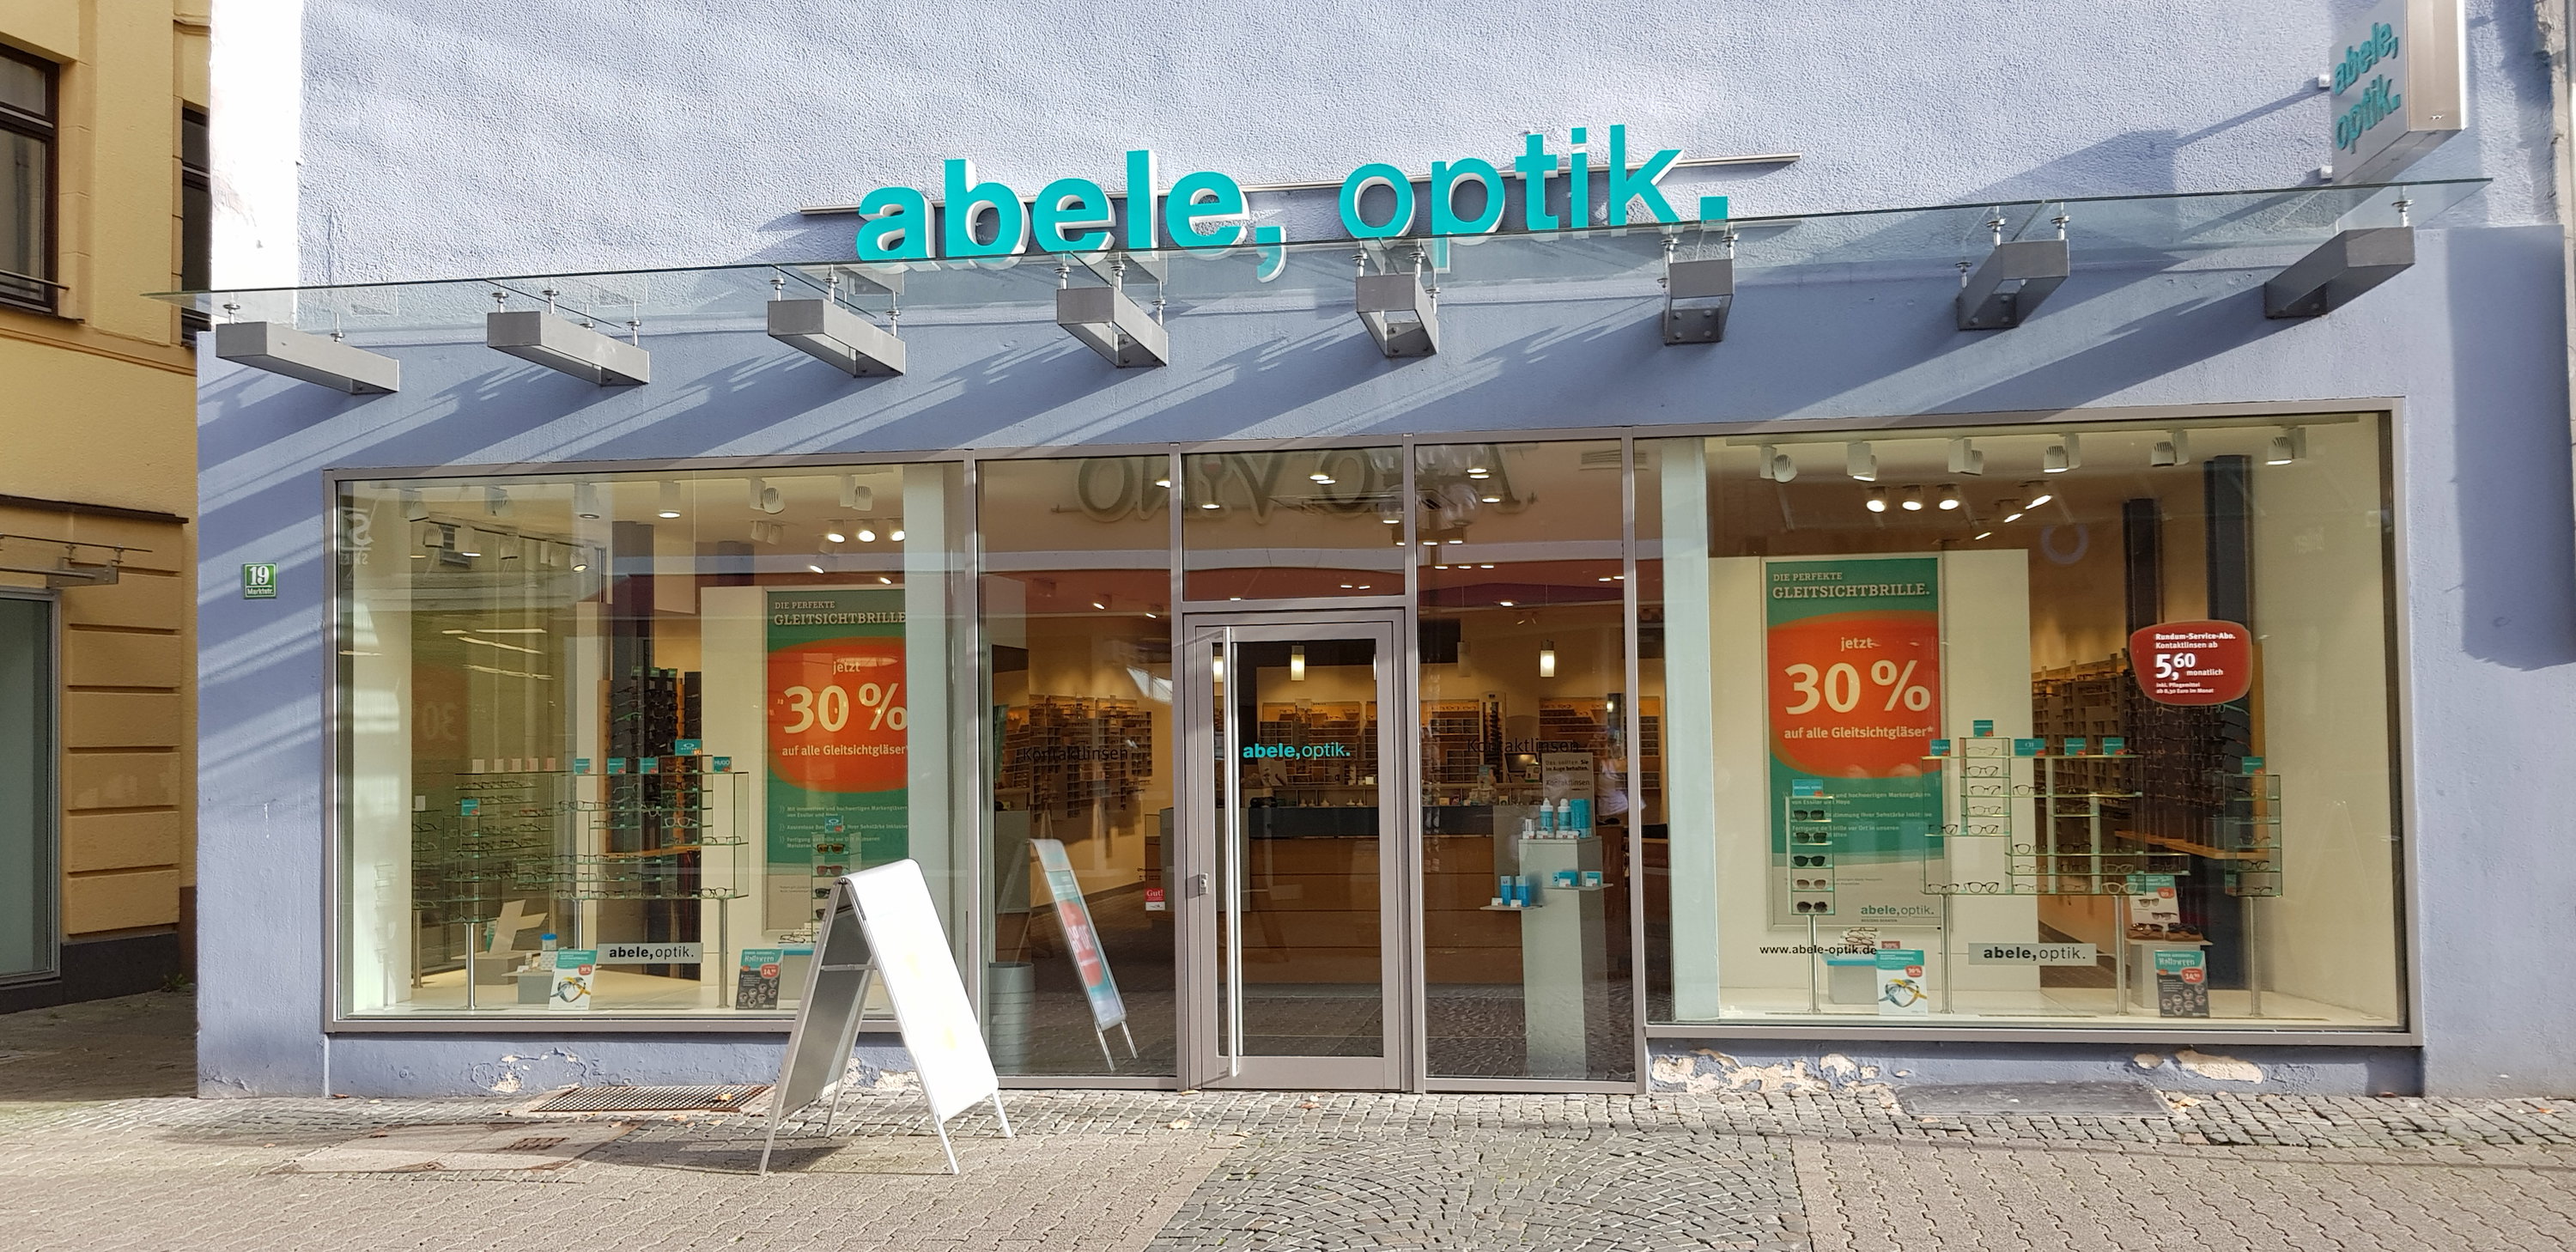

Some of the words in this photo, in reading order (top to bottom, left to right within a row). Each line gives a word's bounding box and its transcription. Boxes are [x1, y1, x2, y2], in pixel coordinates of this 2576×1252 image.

[2334, 22, 2399, 96] abele,
[2336, 74, 2402, 155] optik.
[855, 149, 1288, 283] abele,
[1338, 124, 1730, 274] optik.
[249, 565, 270, 586] 19
[1772, 573, 1790, 581] DIE
[1793, 572, 1843, 581] PERFEKTE
[1772, 583, 1930, 599] GLEITSICHTBRILLE.
[1840, 636, 1874, 652] jetzt
[2155, 632, 2236, 641] Rundum-Service-Abo.
[833, 660, 860, 675] jetzt
[1784, 662, 1862, 715] 30
[1870, 659, 1931, 712] %
[783, 685, 849, 734] 30
[1784, 727, 1803, 738] auf
[1807, 727, 1828, 738] alle
[782, 745, 799, 756] auf
[801, 745, 820, 756] alle
[1467, 738, 1580, 753] Kontaktlinsen
[1023, 746, 1128, 761] Kontaktlinsen
[1759, 945, 1877, 956] www.abele-optik.de
